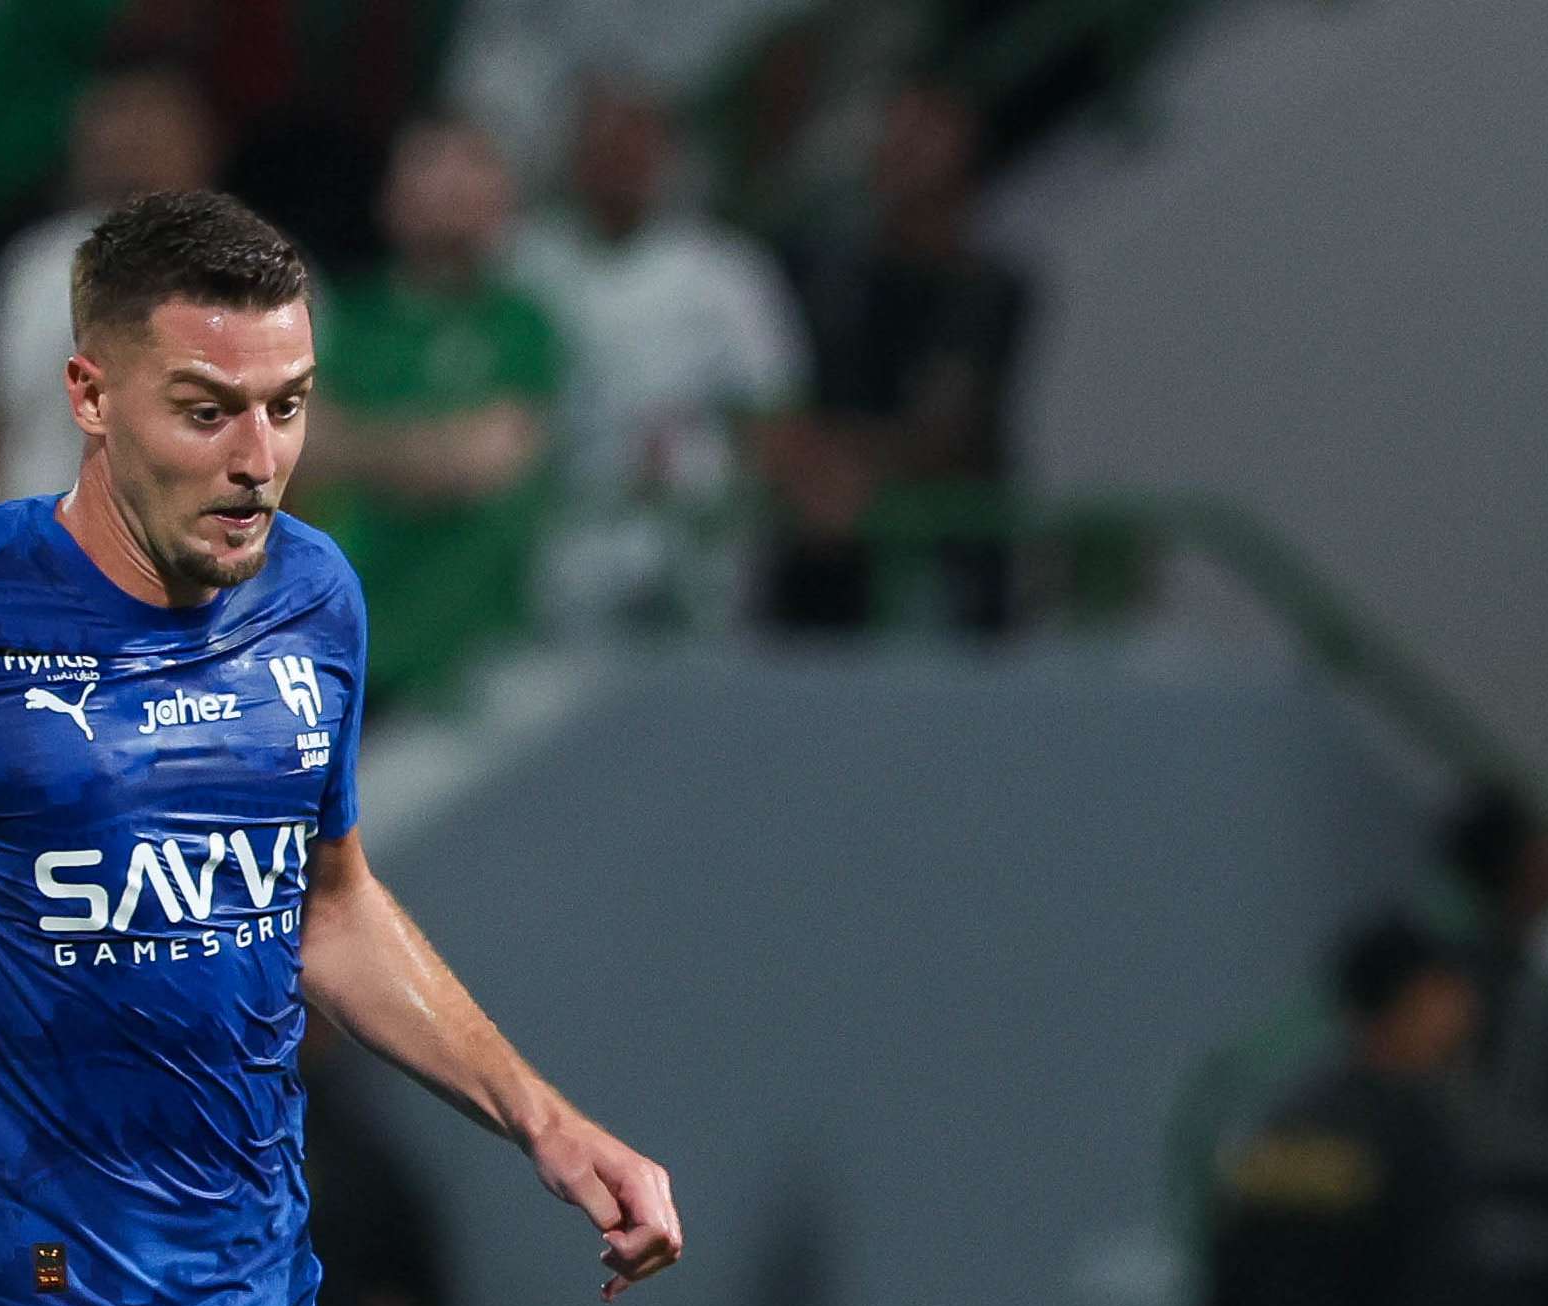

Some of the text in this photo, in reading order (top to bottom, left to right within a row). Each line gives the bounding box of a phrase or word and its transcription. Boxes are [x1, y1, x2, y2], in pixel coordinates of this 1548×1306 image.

[138, 688, 242, 734] jahez
[54, 904, 301, 967] GAMES GRO
